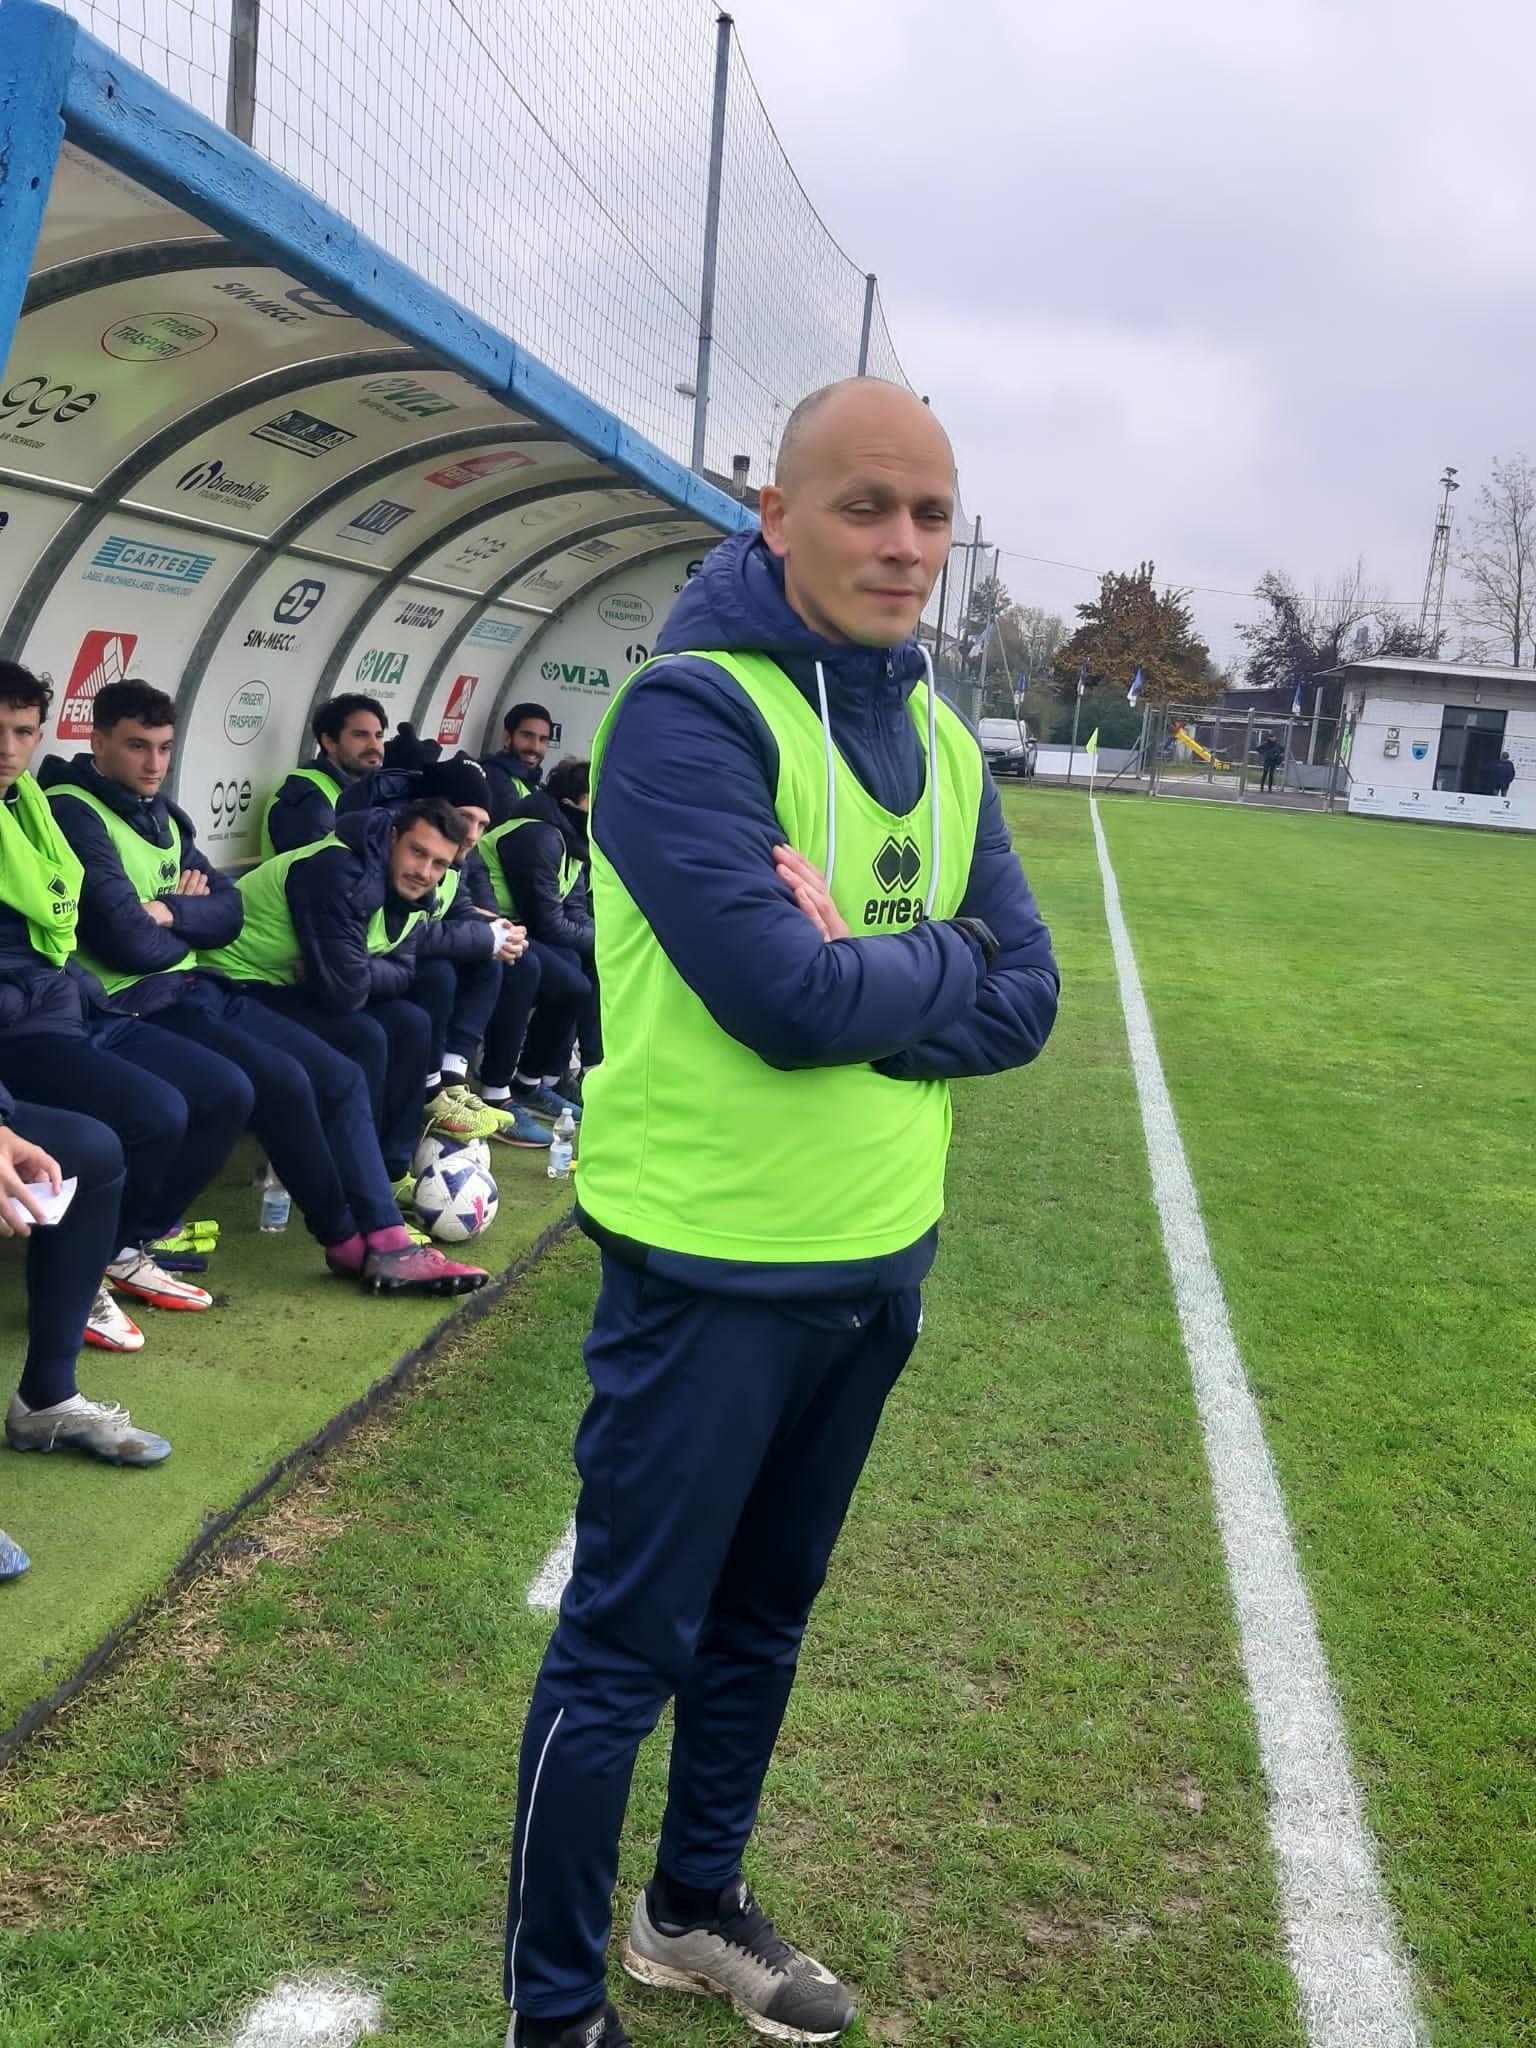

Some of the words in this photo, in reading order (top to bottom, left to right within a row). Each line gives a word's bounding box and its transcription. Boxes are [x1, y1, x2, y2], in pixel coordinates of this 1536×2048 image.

[0, 376, 97, 428] gge
[207, 471, 269, 503] brambilla
[121, 548, 190, 573] CARTES
[243, 629, 296, 651] SIN-MECC
[561, 663, 610, 688] VIPA
[210, 780, 252, 828] gge
